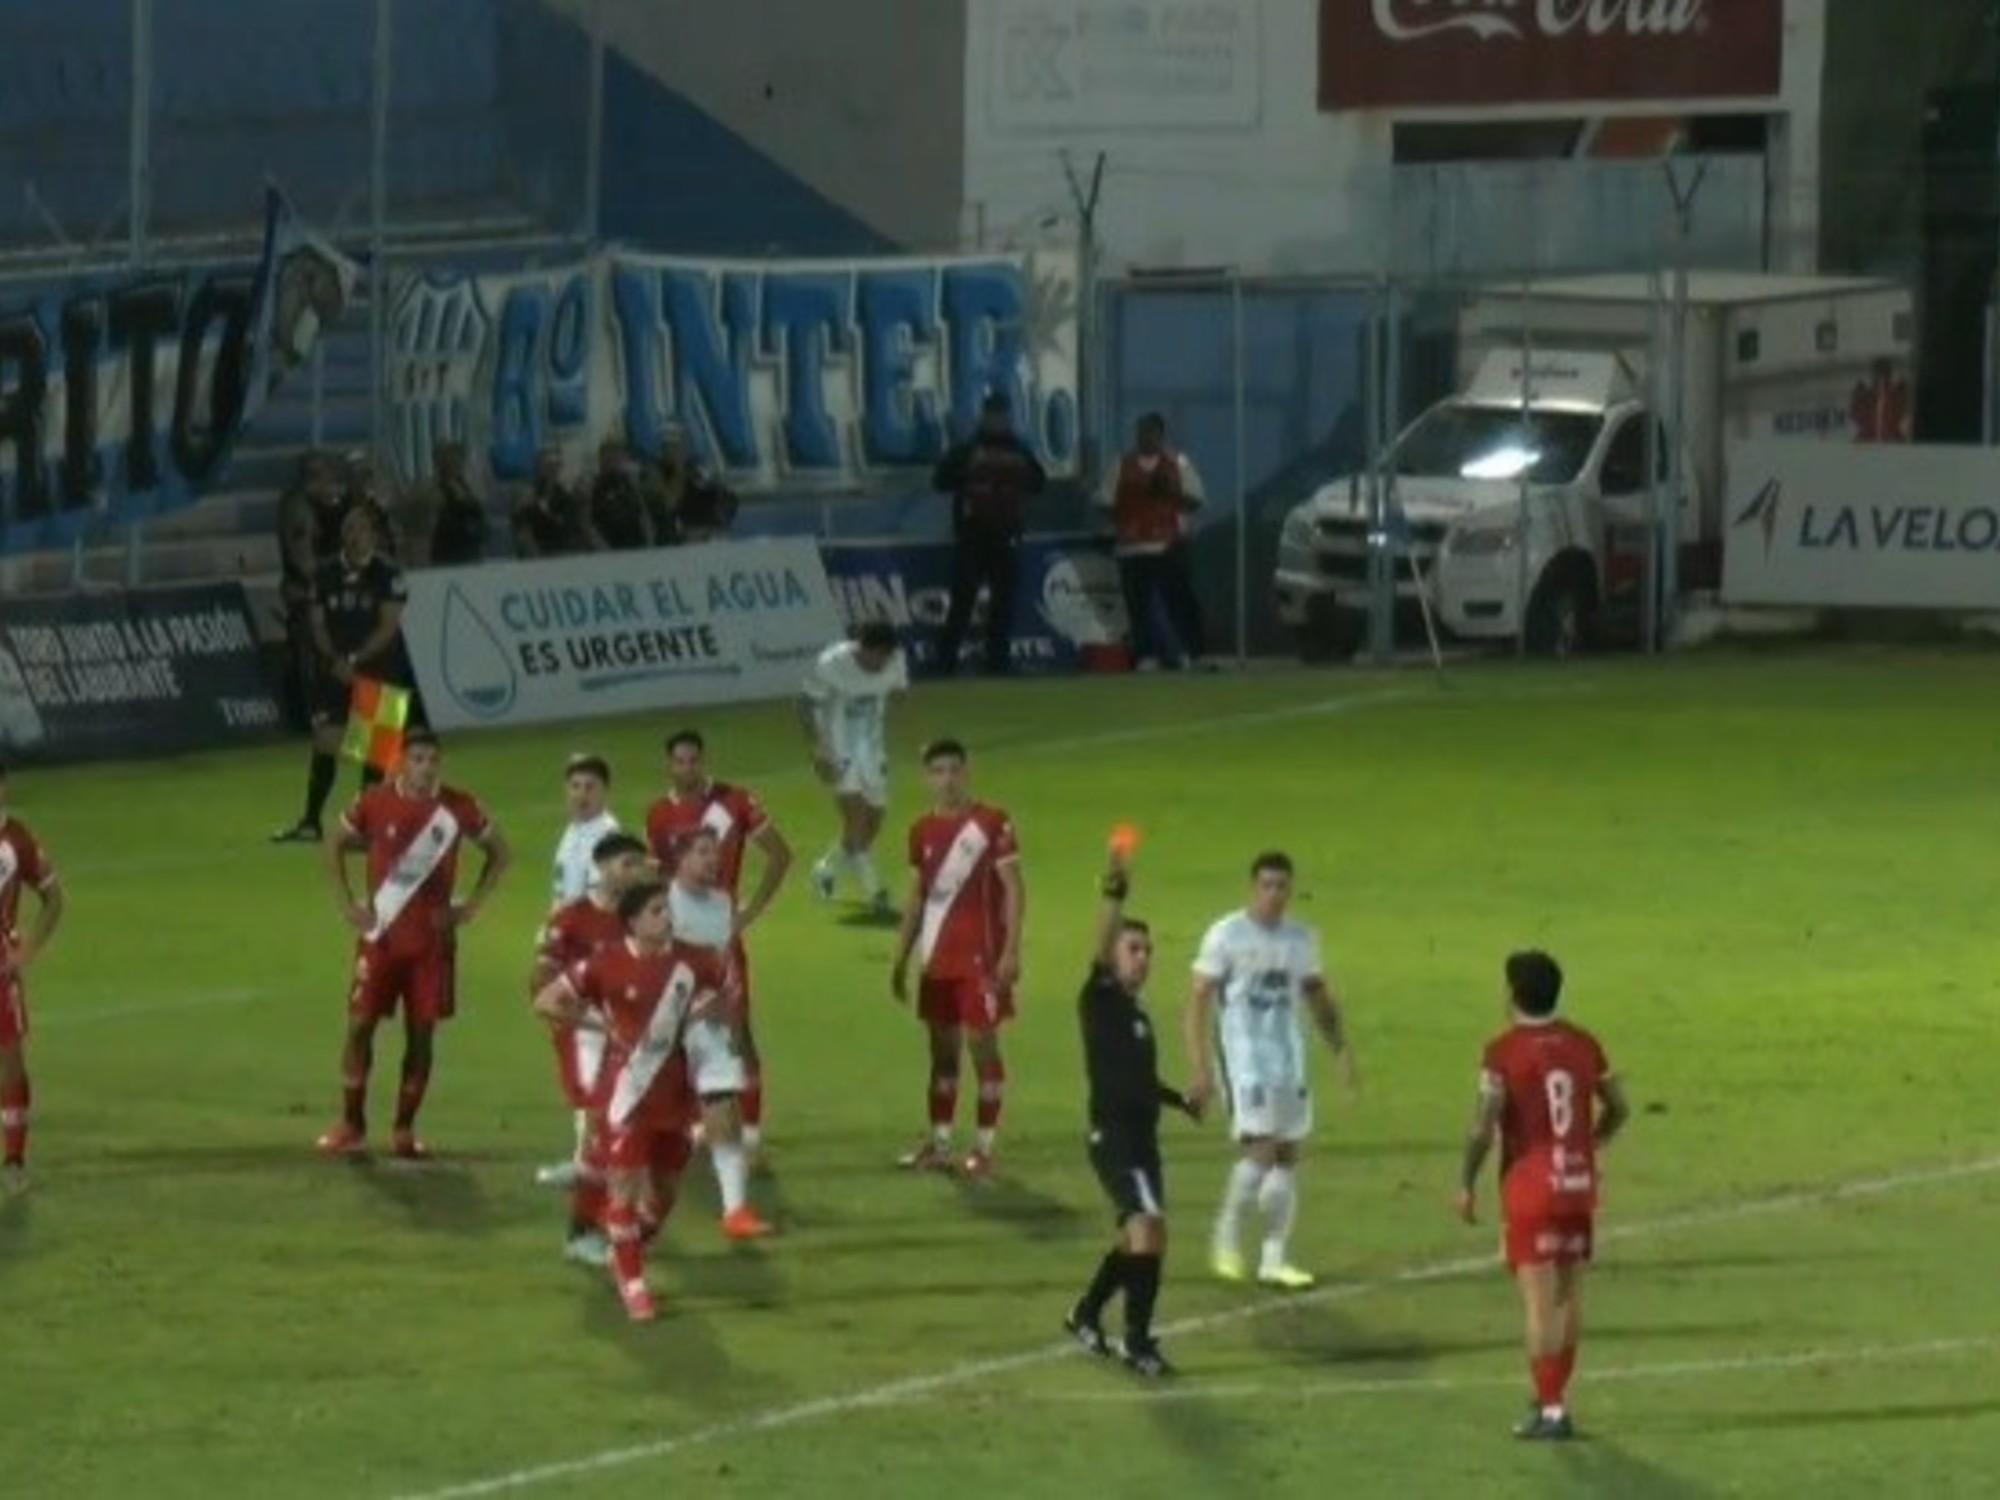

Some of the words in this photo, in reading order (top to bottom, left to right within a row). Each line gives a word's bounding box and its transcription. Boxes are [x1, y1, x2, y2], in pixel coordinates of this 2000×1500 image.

[1798, 505, 1860, 548] LA
[1870, 505, 2000, 551] VELO
[500, 580, 643, 633] CUIDAR
[654, 576, 693, 621] EL
[704, 568, 811, 613] AGUA
[518, 640, 561, 676] ES
[566, 624, 719, 670] URGENTE
[1545, 1069, 1574, 1138] 8
